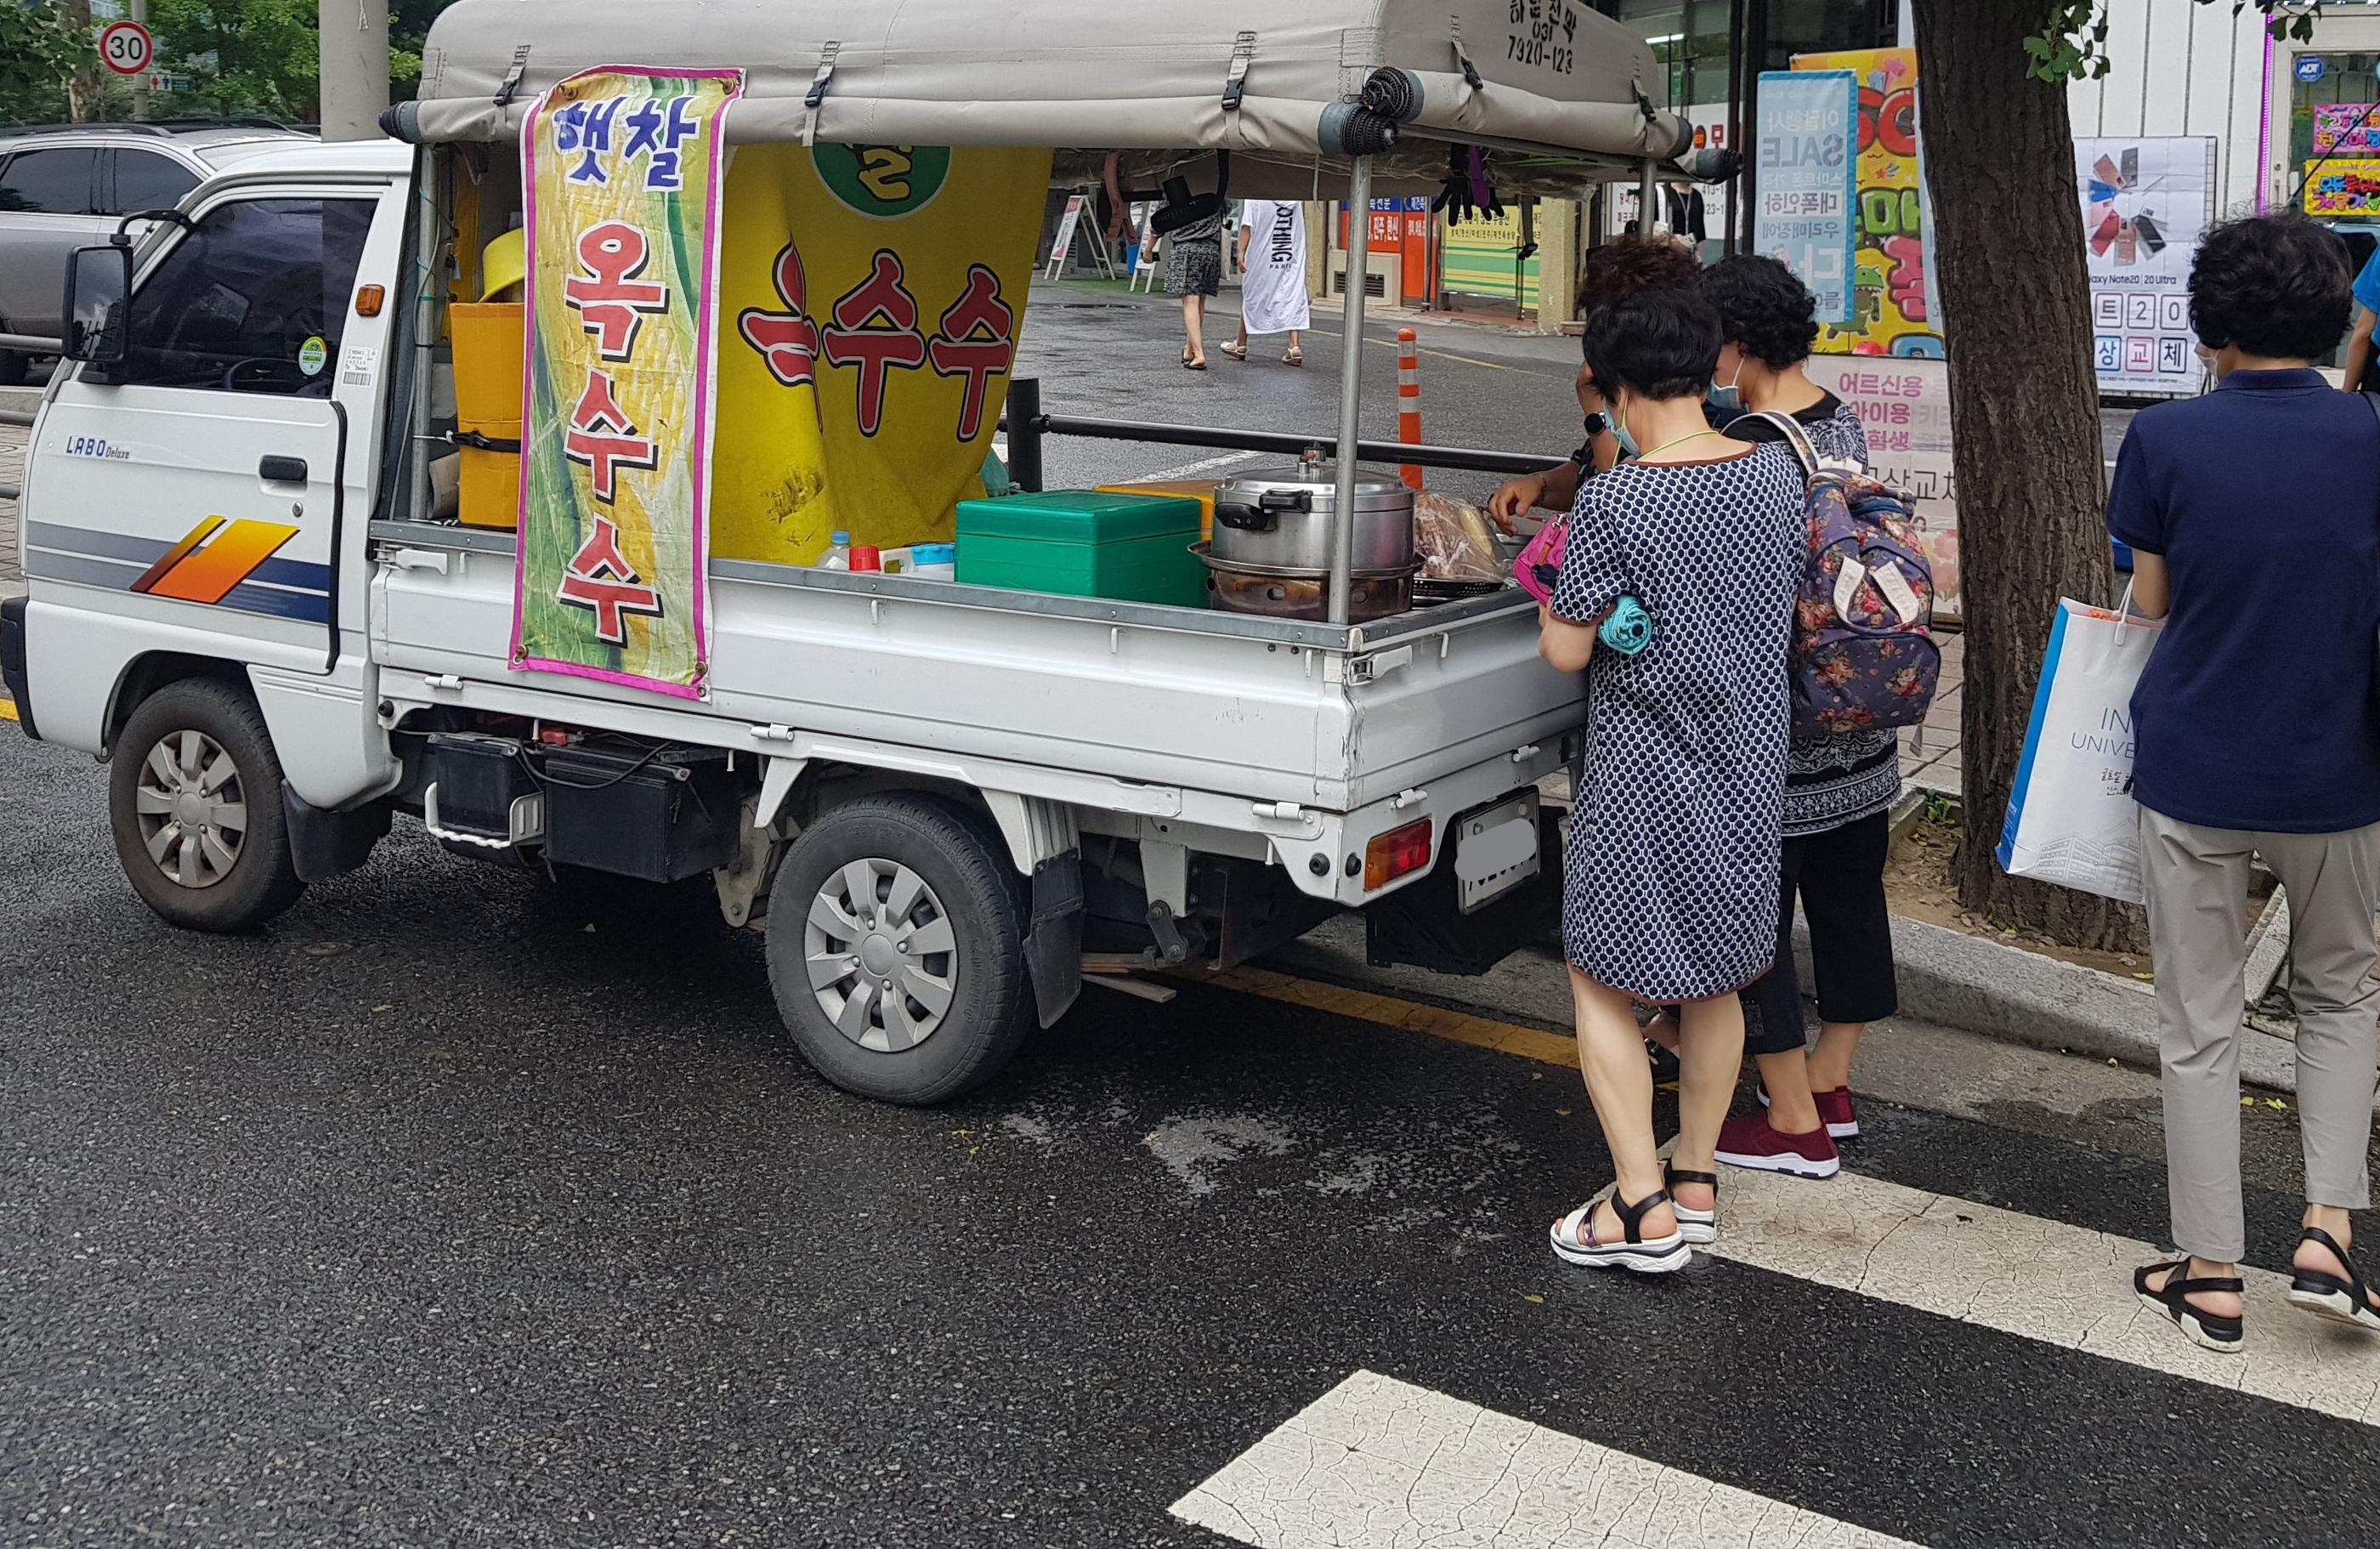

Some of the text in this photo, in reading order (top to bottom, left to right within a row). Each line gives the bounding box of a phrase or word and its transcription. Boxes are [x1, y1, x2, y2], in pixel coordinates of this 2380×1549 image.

[1533, 20, 1553, 42] 031
[110, 36, 143, 60] 30
[1508, 35, 1572, 75] 7920-123
[2299, 63, 2320, 74] ADT
[552, 94, 701, 191] 햇찰
[2109, 275, 2140, 284] Note20
[2144, 275, 2155, 284] 20
[2156, 275, 2177, 285] Ultra
[1839, 372, 1924, 398] 어르신용
[1850, 400, 1911, 424] 아이용
[556, 218, 670, 650] 옥수수
[1867, 429, 1910, 452] 험생
[66, 435, 130, 460] LABO Deluxe
[2101, 706, 2133, 734] IN
[2071, 731, 2135, 759] UNIVE
